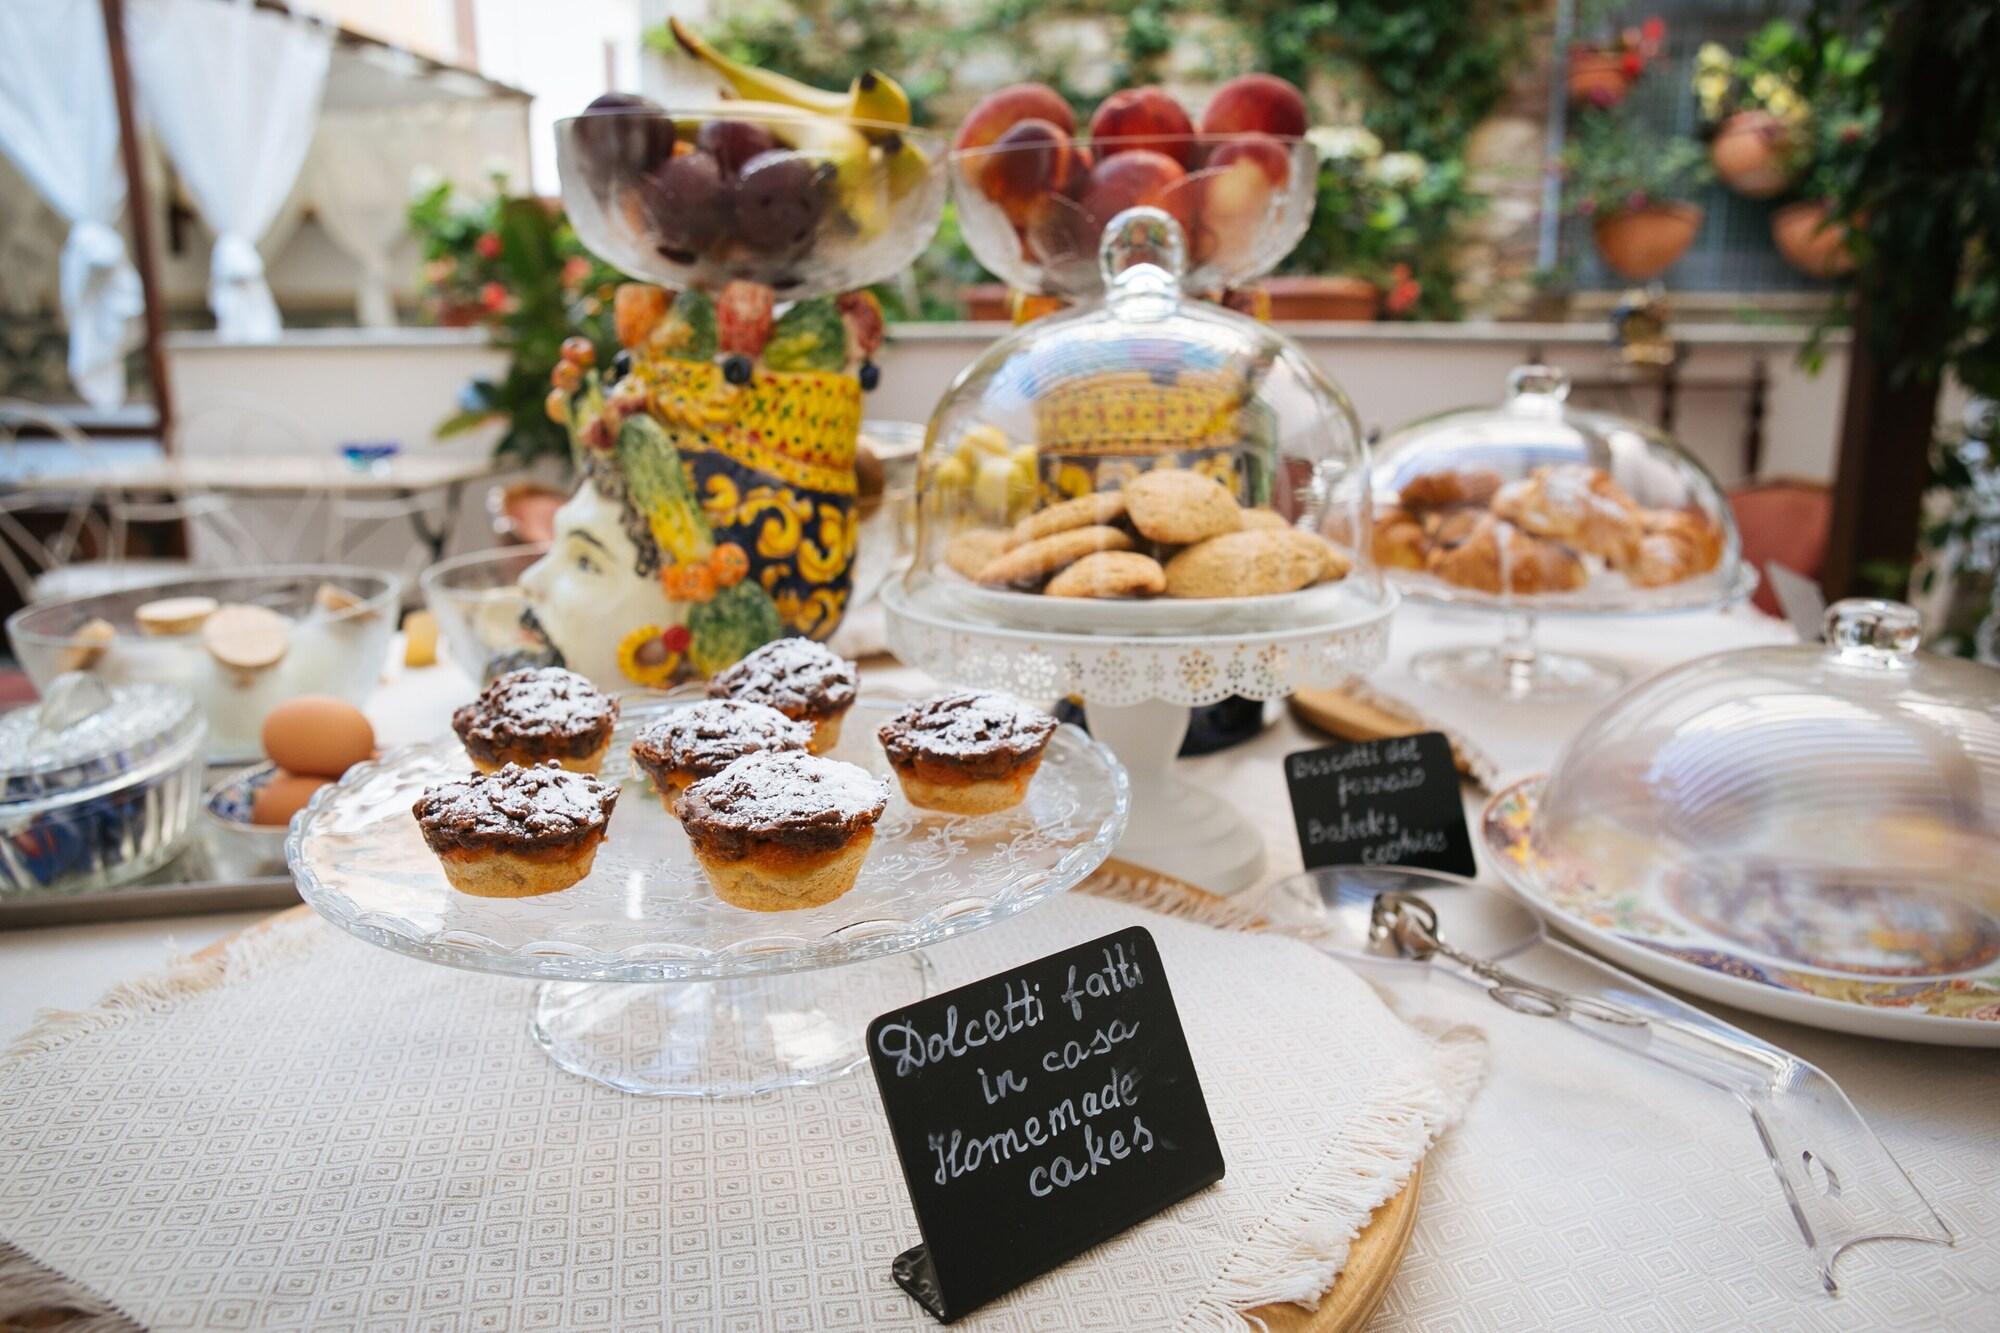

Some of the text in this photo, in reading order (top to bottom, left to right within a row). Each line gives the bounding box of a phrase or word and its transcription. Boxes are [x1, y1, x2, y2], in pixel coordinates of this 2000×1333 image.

[1293, 738, 1421, 779] Biscotti del
[1338, 767, 1426, 807] fornaio
[1361, 828, 1448, 866] cookies
[878, 943, 1143, 1077] Dolcetti fatti
[976, 1019, 1140, 1104] in casa
[929, 1067, 1141, 1185] Homemade
[1029, 1116, 1154, 1197] cakes
